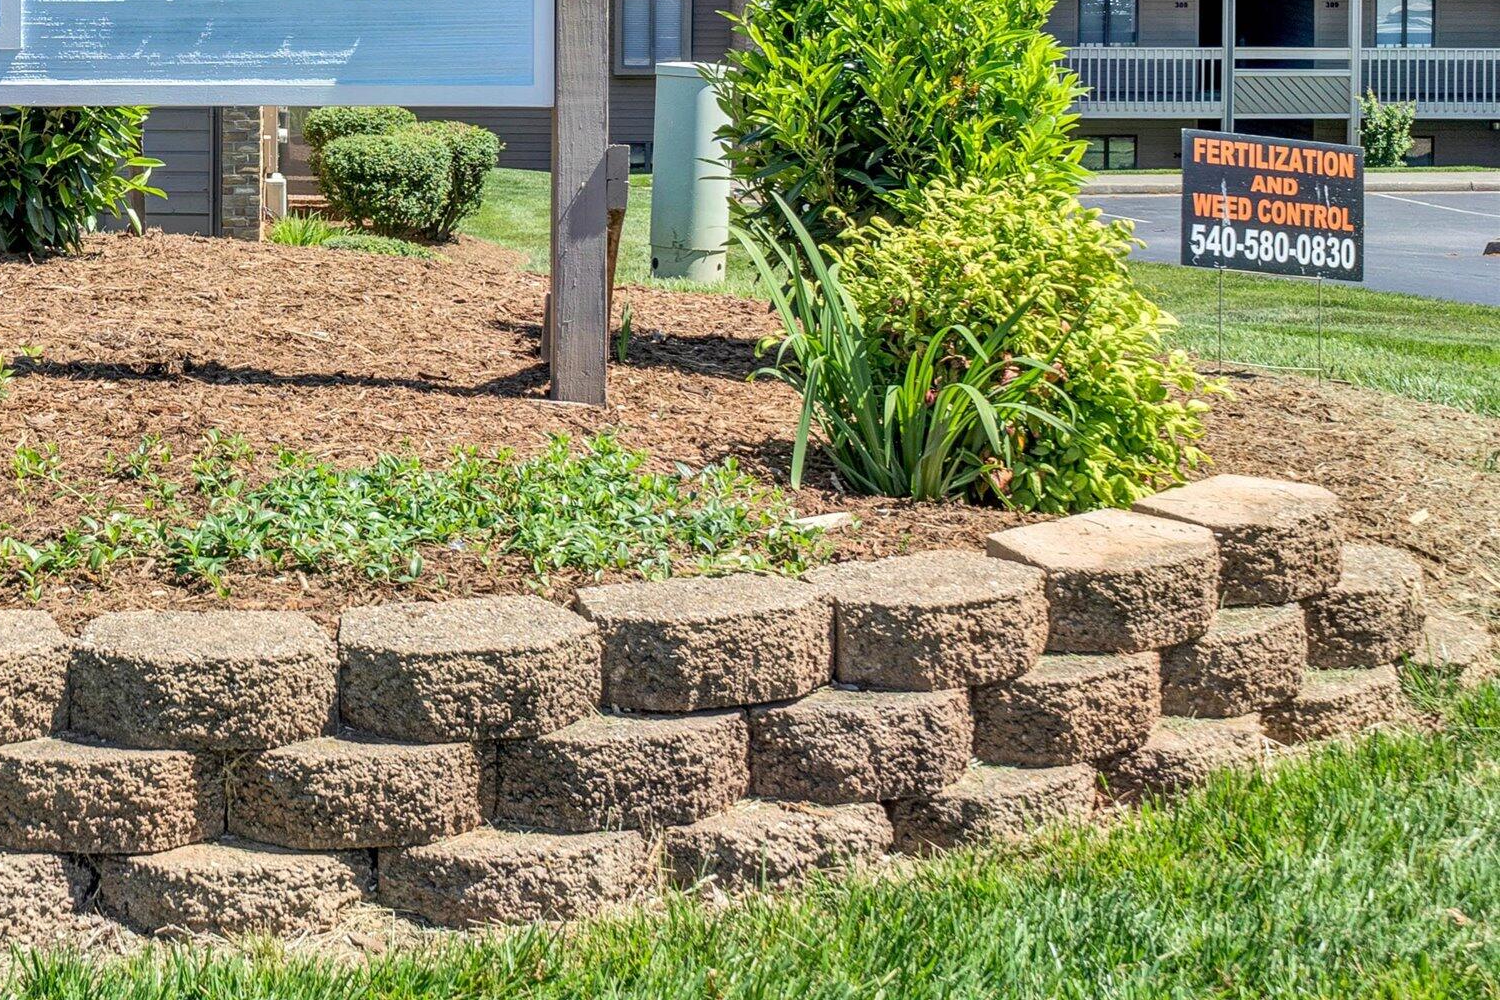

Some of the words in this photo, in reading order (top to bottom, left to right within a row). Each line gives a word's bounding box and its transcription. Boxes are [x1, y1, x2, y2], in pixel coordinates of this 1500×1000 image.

[1193, 137, 1355, 178] FERTILIZATION
[1250, 175, 1298, 196] AND
[1192, 192, 1252, 222] WEED
[1257, 199, 1355, 232] CONTROL
[1190, 223, 1356, 270] 540-580-0830
